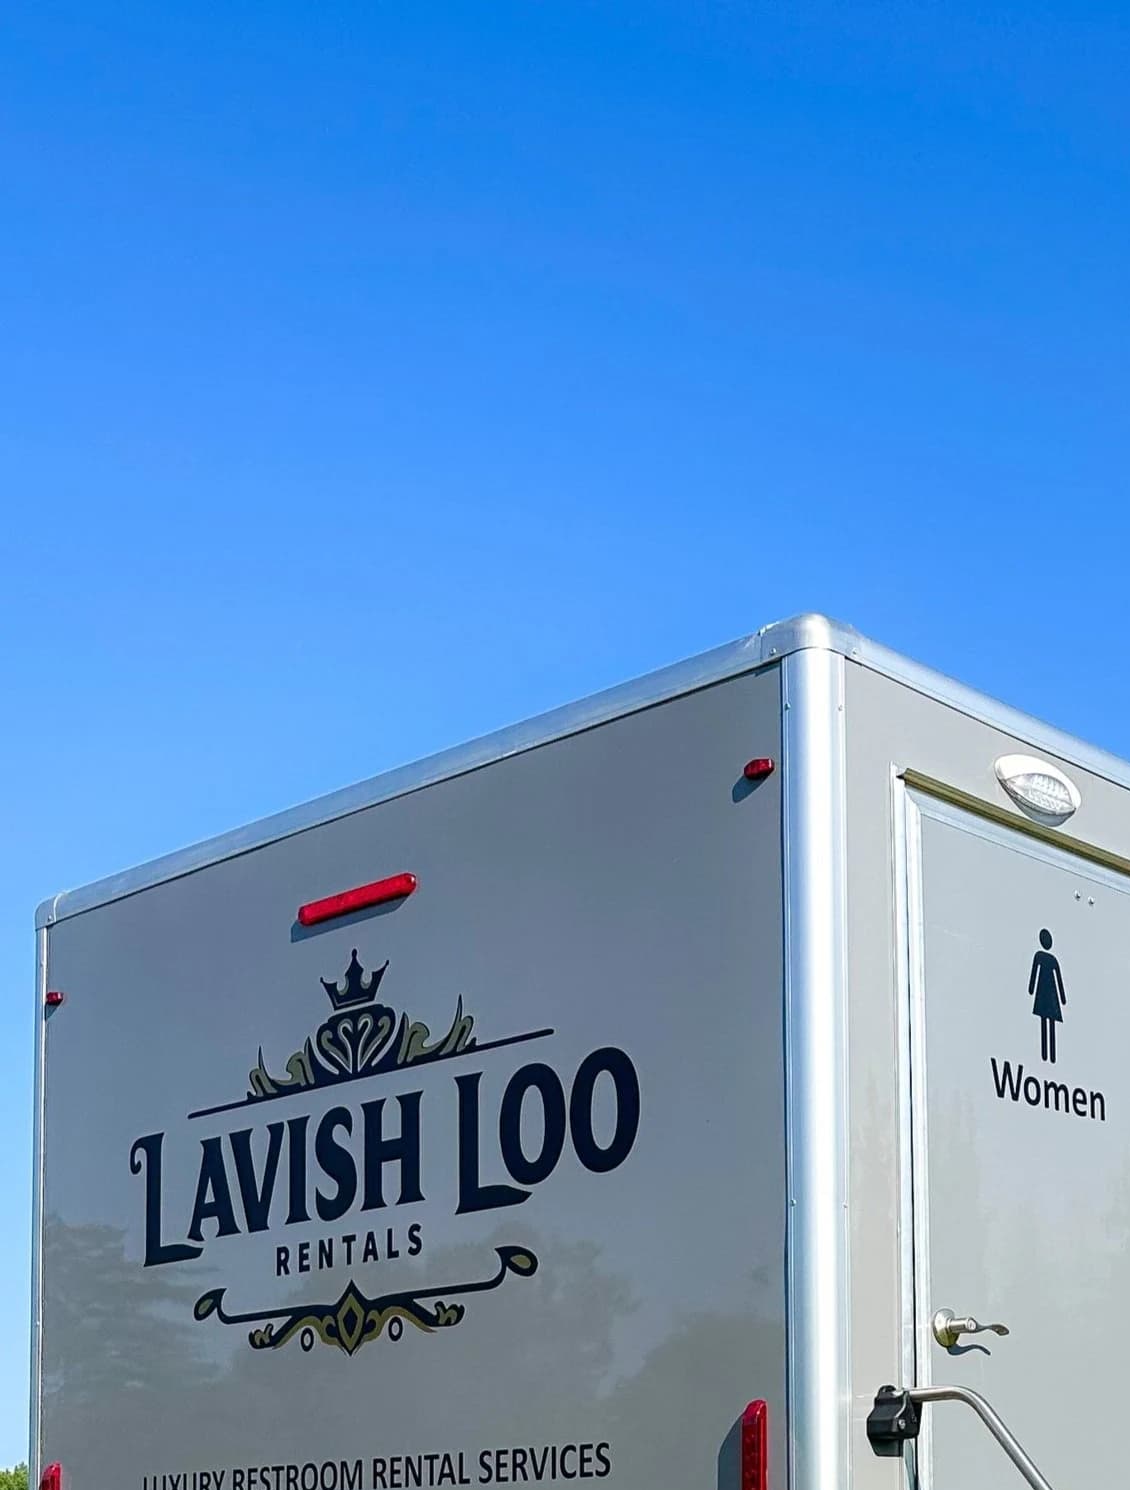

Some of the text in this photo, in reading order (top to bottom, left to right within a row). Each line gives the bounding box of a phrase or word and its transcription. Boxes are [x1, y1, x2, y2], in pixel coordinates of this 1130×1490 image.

[990, 1057, 1106, 1121] Women
[130, 1047, 641, 1268] LAVISH LOO
[276, 1223, 424, 1277] RENTALS
[372, 1451, 472, 1490] RENTAL
[478, 1442, 612, 1485] SERVICES
